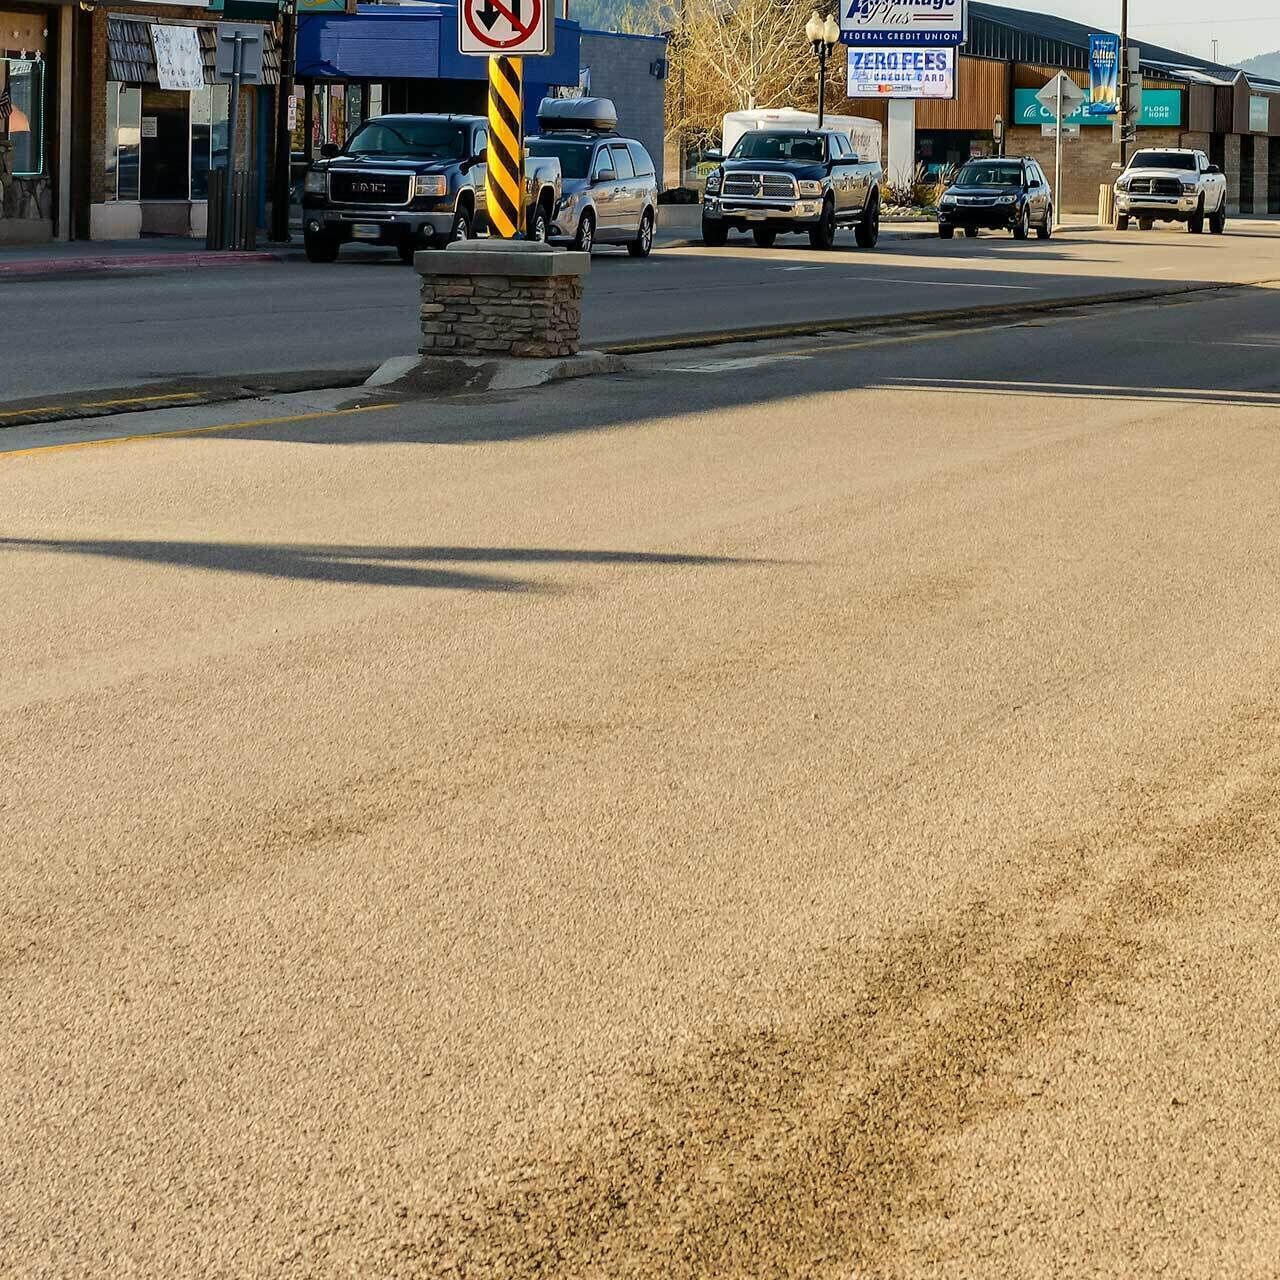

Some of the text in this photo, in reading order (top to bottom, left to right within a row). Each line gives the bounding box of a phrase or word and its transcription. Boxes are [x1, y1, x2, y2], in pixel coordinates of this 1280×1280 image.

[843, 32, 958, 40] FEDERAL CREDIT UNION
[853, 52, 947, 70] ZERO FEES
[874, 73, 944, 81] CREDIT CARD
[352, 183, 386, 193] GMC
